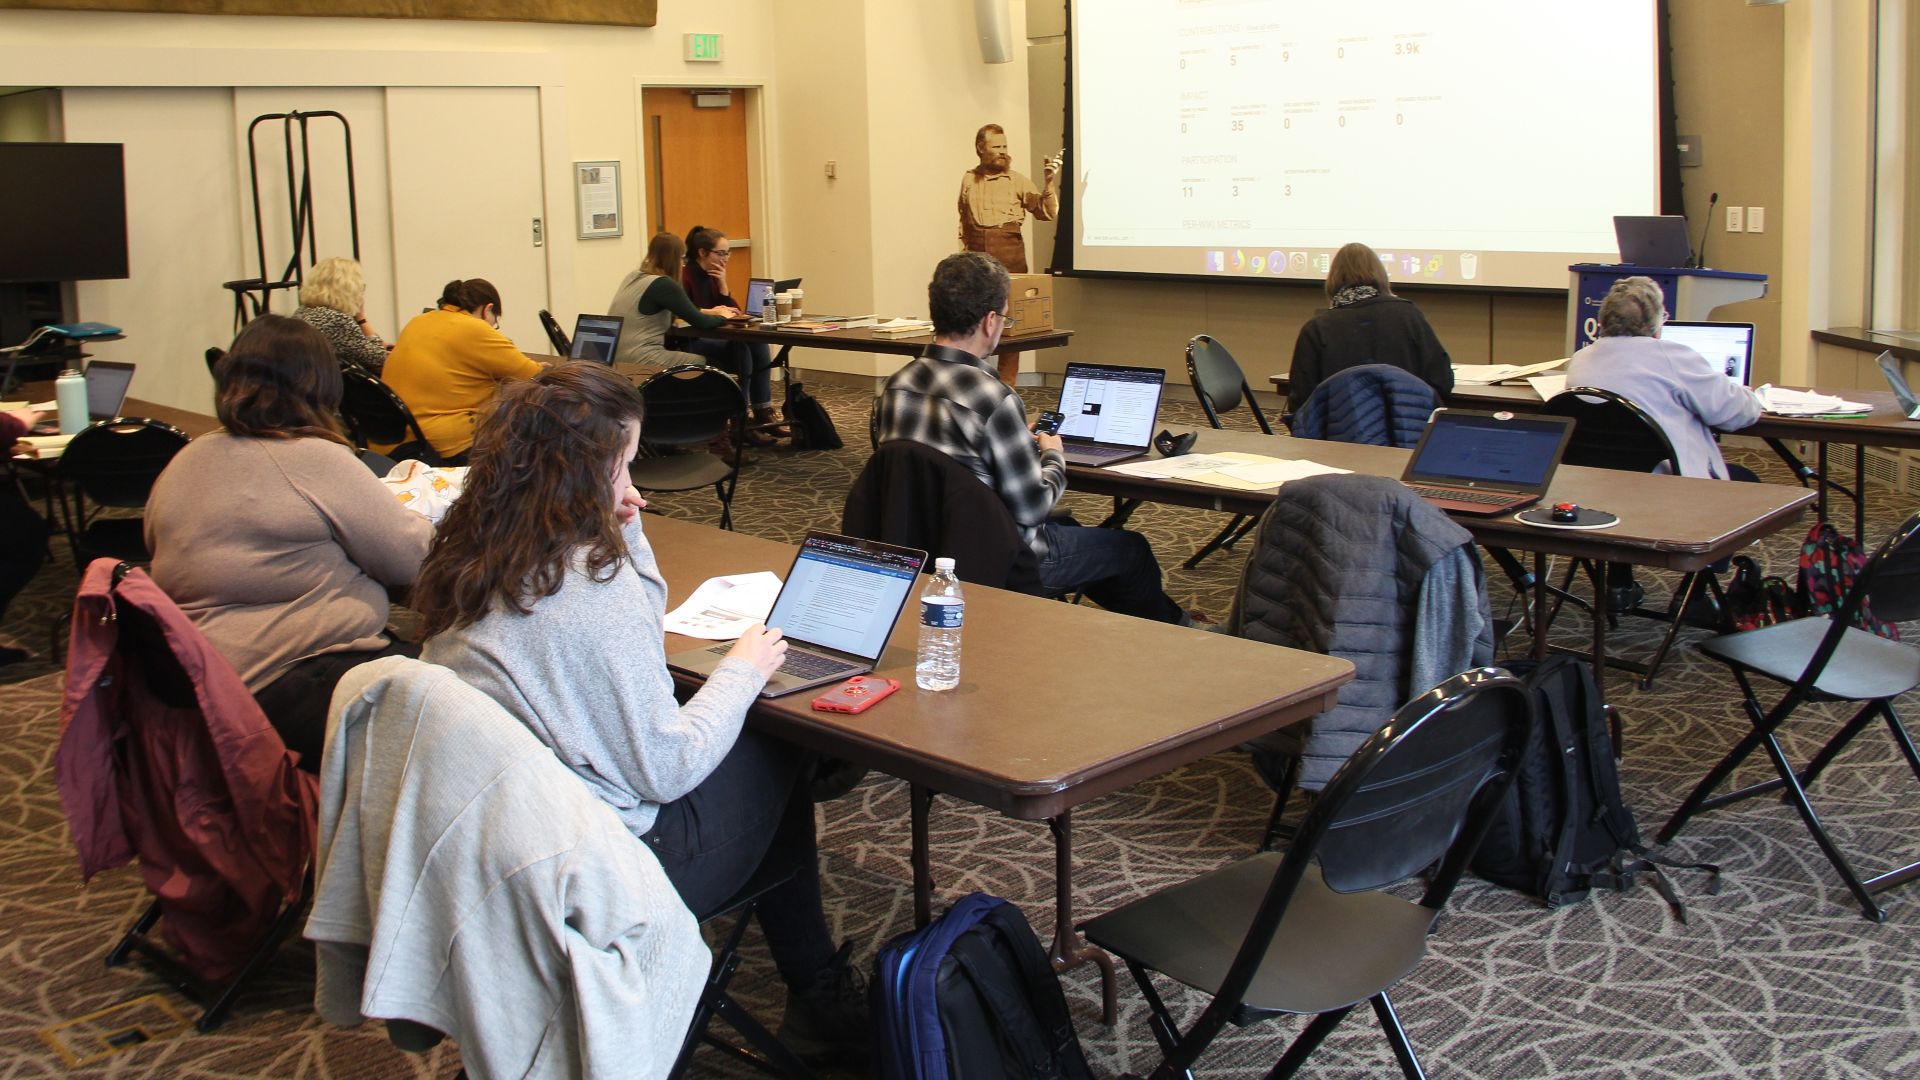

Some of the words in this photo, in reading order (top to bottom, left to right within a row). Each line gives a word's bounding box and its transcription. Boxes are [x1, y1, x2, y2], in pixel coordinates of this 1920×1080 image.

[694, 35, 719, 58] EXIT
[1179, 58, 1186, 70] 0
[1230, 54, 1237, 66] 5
[1282, 50, 1289, 62] 9
[1337, 47, 1345, 58] 0
[1394, 41, 1421, 55] 3.9k
[1181, 122, 1187, 134] 0
[1231, 120, 1244, 131] 35
[1284, 118, 1290, 129] 0
[1338, 115, 1345, 127] 0
[1396, 113, 1403, 125] 0
[1182, 187, 1193, 198] 11
[1232, 185, 1239, 197] 3
[1284, 185, 1292, 196] 3
